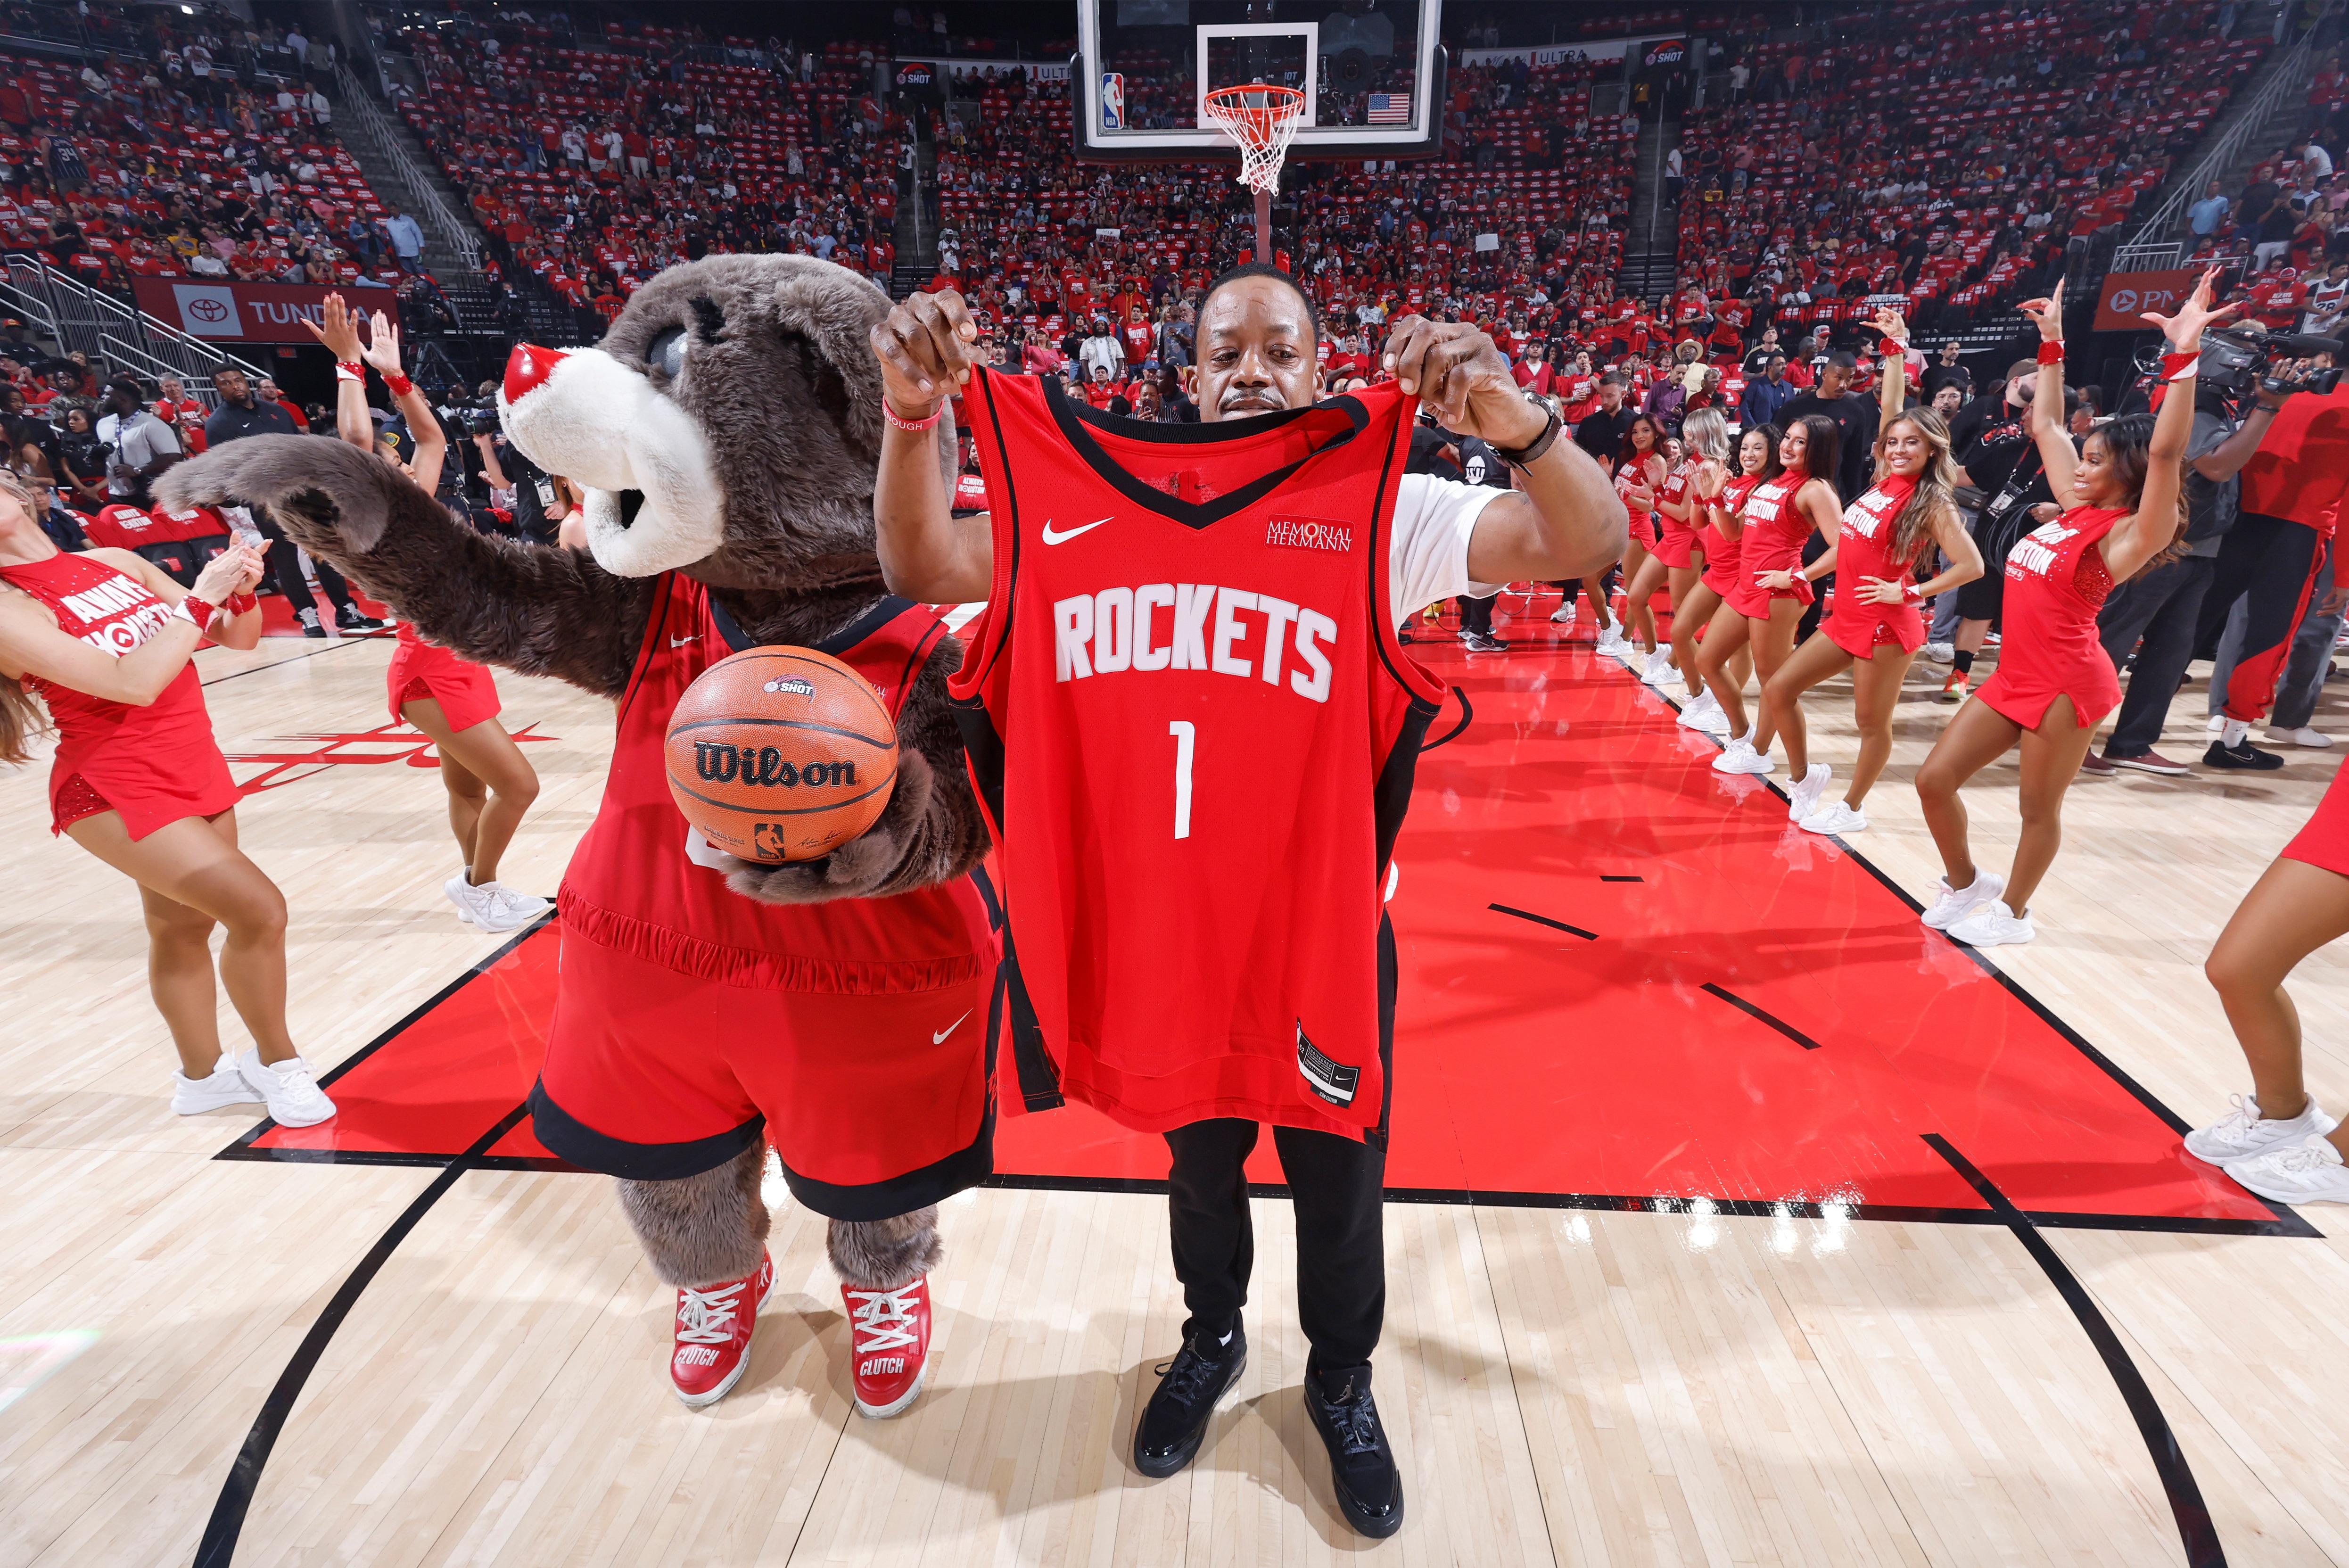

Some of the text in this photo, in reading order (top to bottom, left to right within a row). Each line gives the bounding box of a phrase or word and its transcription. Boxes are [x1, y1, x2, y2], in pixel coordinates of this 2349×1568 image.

[1657, 51, 1683, 63] SHOT
[907, 74, 931, 84] SHOT
[1042, 68, 1071, 78] ULT
[1105, 117, 1116, 126] NBA
[58, 149, 80, 161] 34
[249, 301, 371, 325] TUNDA
[1816, 365, 1821, 375] 4
[963, 477, 984, 486] ALWAYS
[958, 484, 985, 494] HOUSTON
[113, 509, 140, 519] ALWAYS
[119, 516, 152, 529] HOUSTON
[1268, 520, 1352, 541] MEMORIAL
[1266, 531, 1351, 552] HERMANN
[59, 574, 154, 624] ALWAYS
[1055, 583, 1336, 702] ROCKETS
[780, 683, 813, 695] SHOT
[694, 741, 856, 787] Wilson
[1169, 720, 1195, 839] 1
[1299, 1044, 1304, 1054] 52
[1309, 1047, 1332, 1068] ENGINEERED
[1326, 1094, 1337, 1104] EDITION
[674, 1348, 719, 1367] CLUTCH
[860, 1357, 905, 1377] CLUTCH
